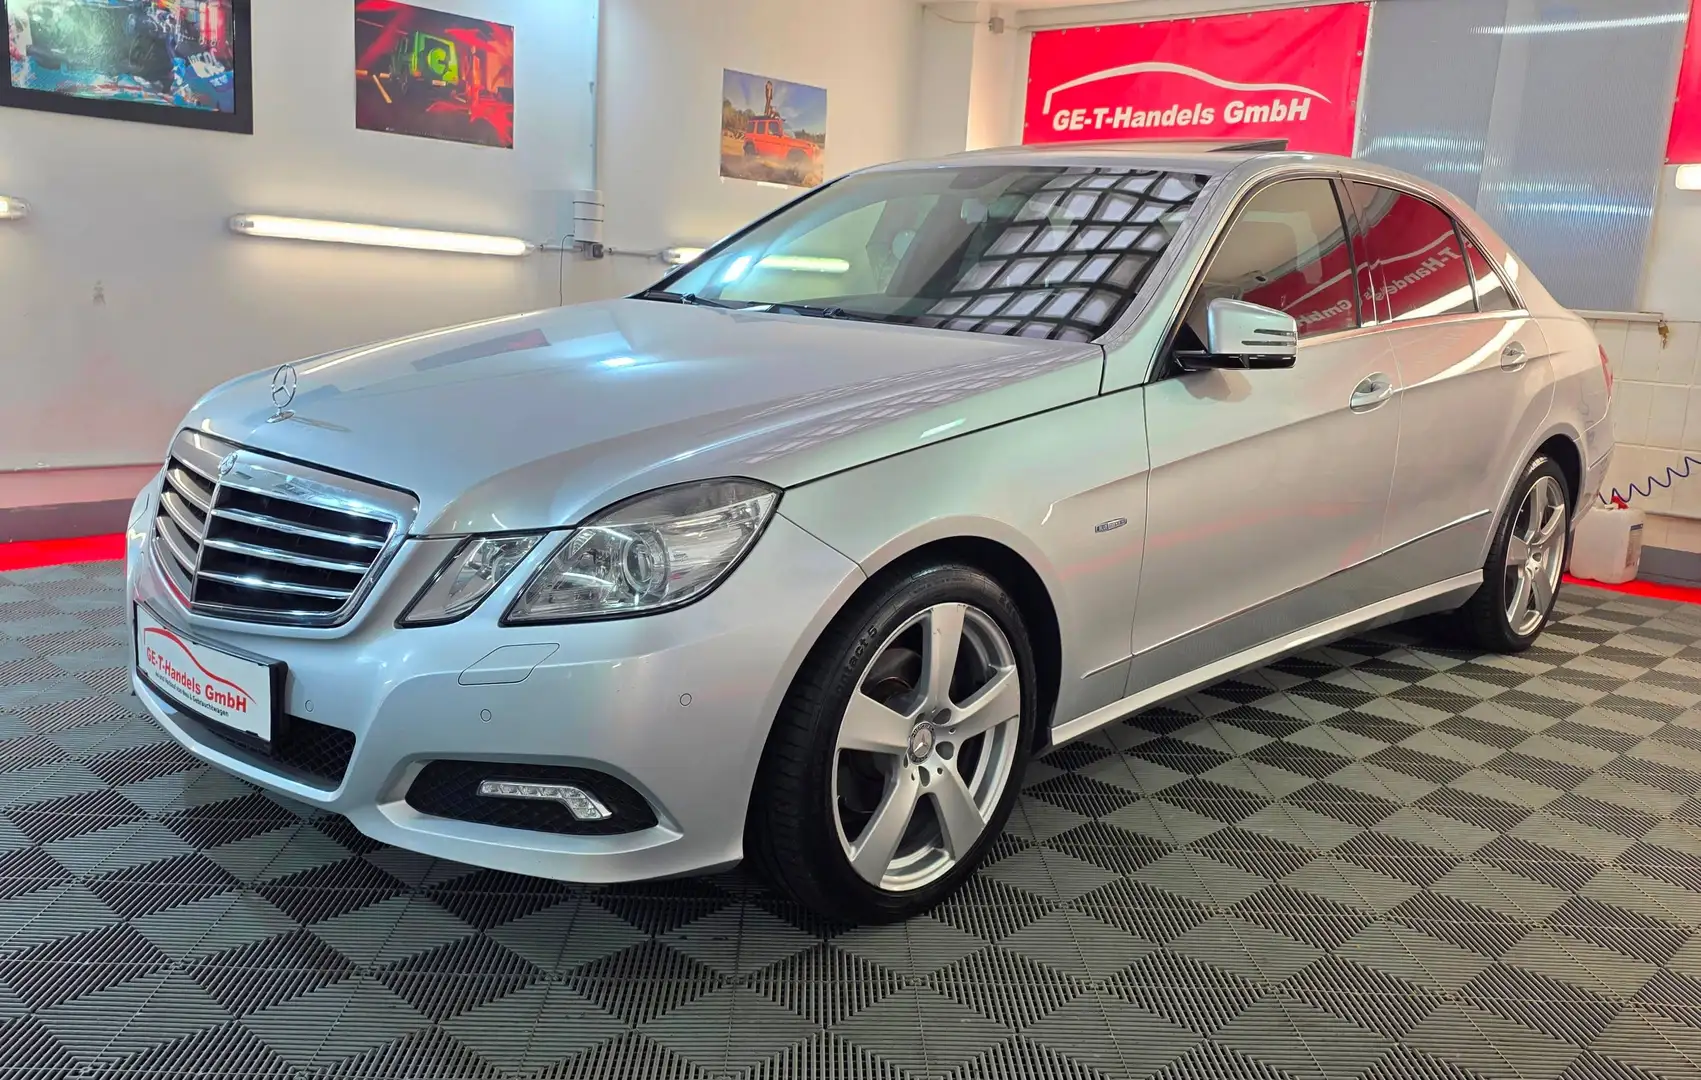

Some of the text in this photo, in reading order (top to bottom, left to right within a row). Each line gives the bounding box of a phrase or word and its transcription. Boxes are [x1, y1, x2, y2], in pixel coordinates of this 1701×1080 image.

[1052, 97, 1311, 131] GE-T-Handels GmbH
[146, 647, 247, 713] GE-T-Handels GmbH
